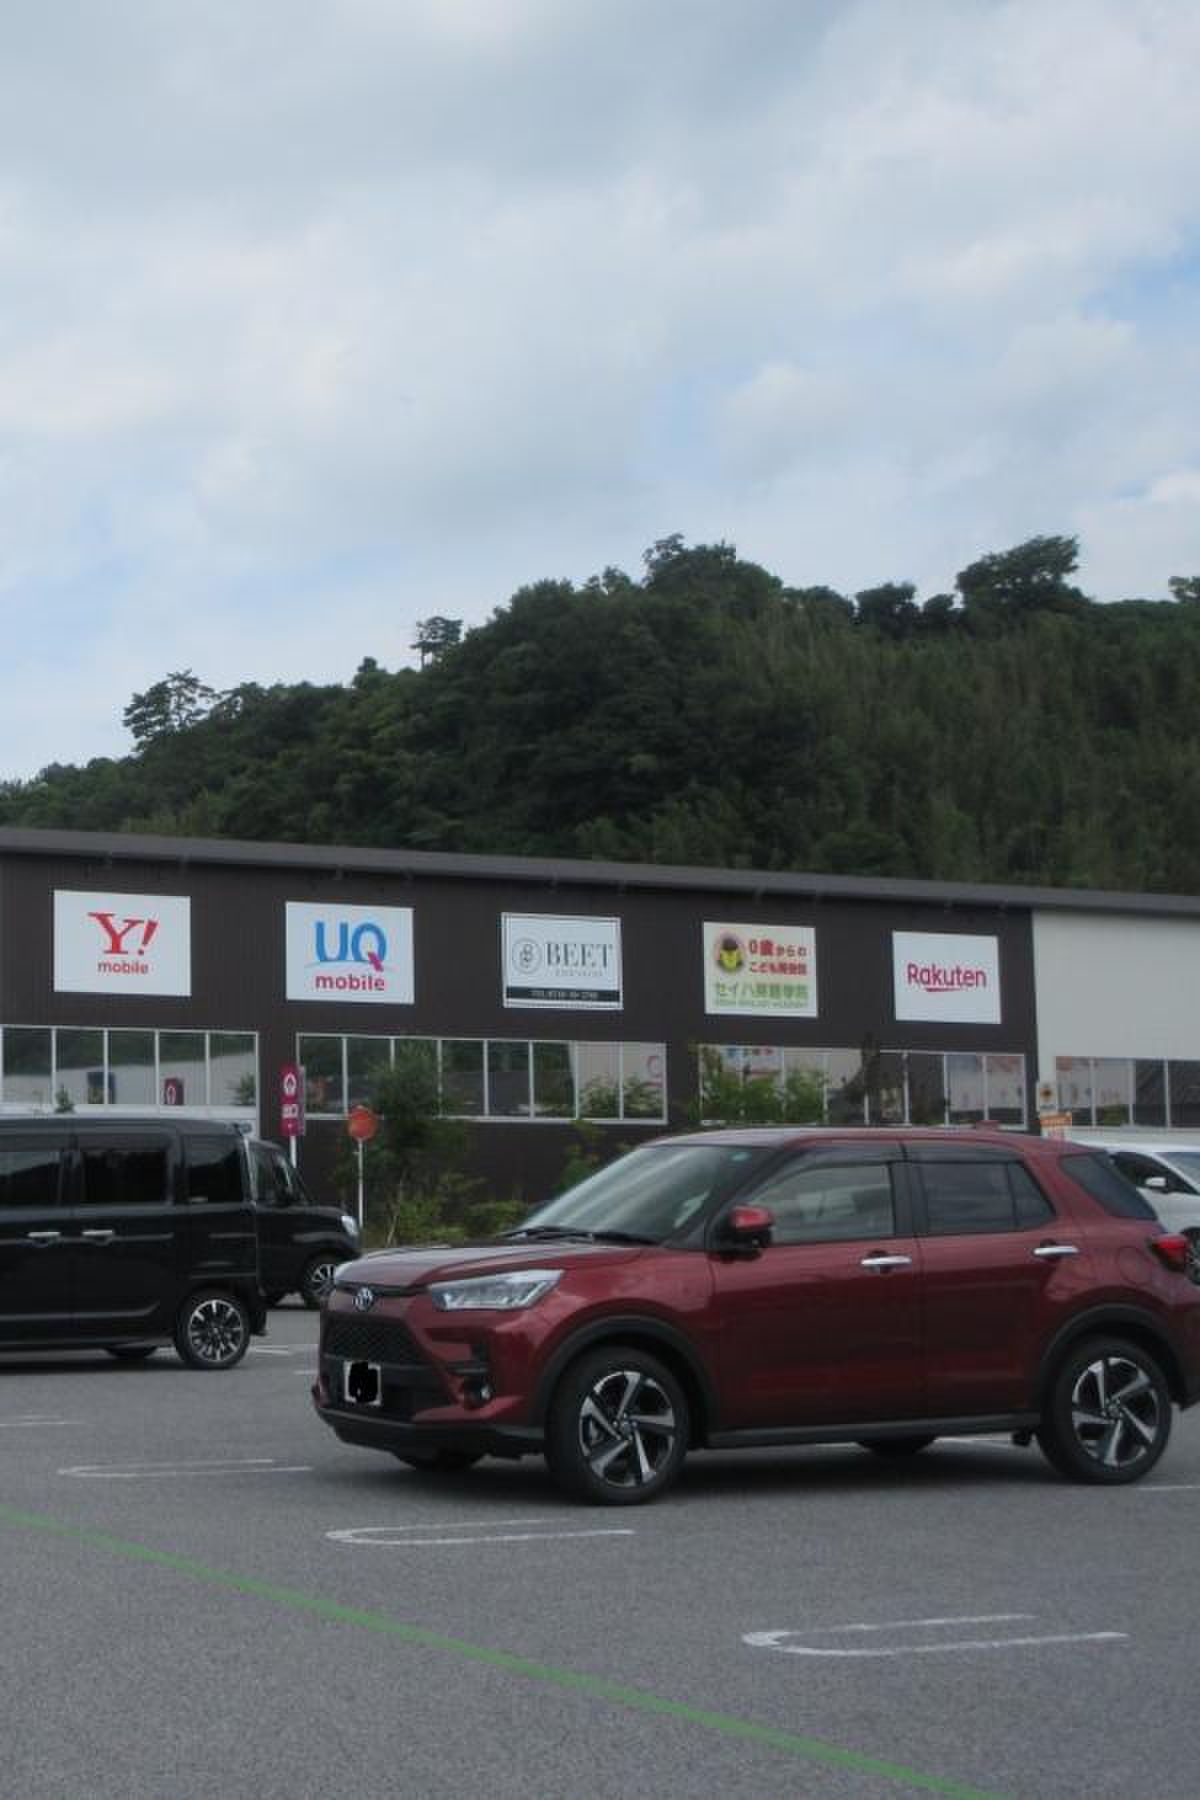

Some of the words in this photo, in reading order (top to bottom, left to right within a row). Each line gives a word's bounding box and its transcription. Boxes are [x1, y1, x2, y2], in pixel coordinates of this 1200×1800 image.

[87, 911, 160, 956] Y!
[314, 920, 388, 973] UQ
[97, 959, 149, 975] mobile
[545, 941, 613, 969] BEET
[315, 973, 386, 992] mobile
[906, 961, 988, 989] Rakuten
